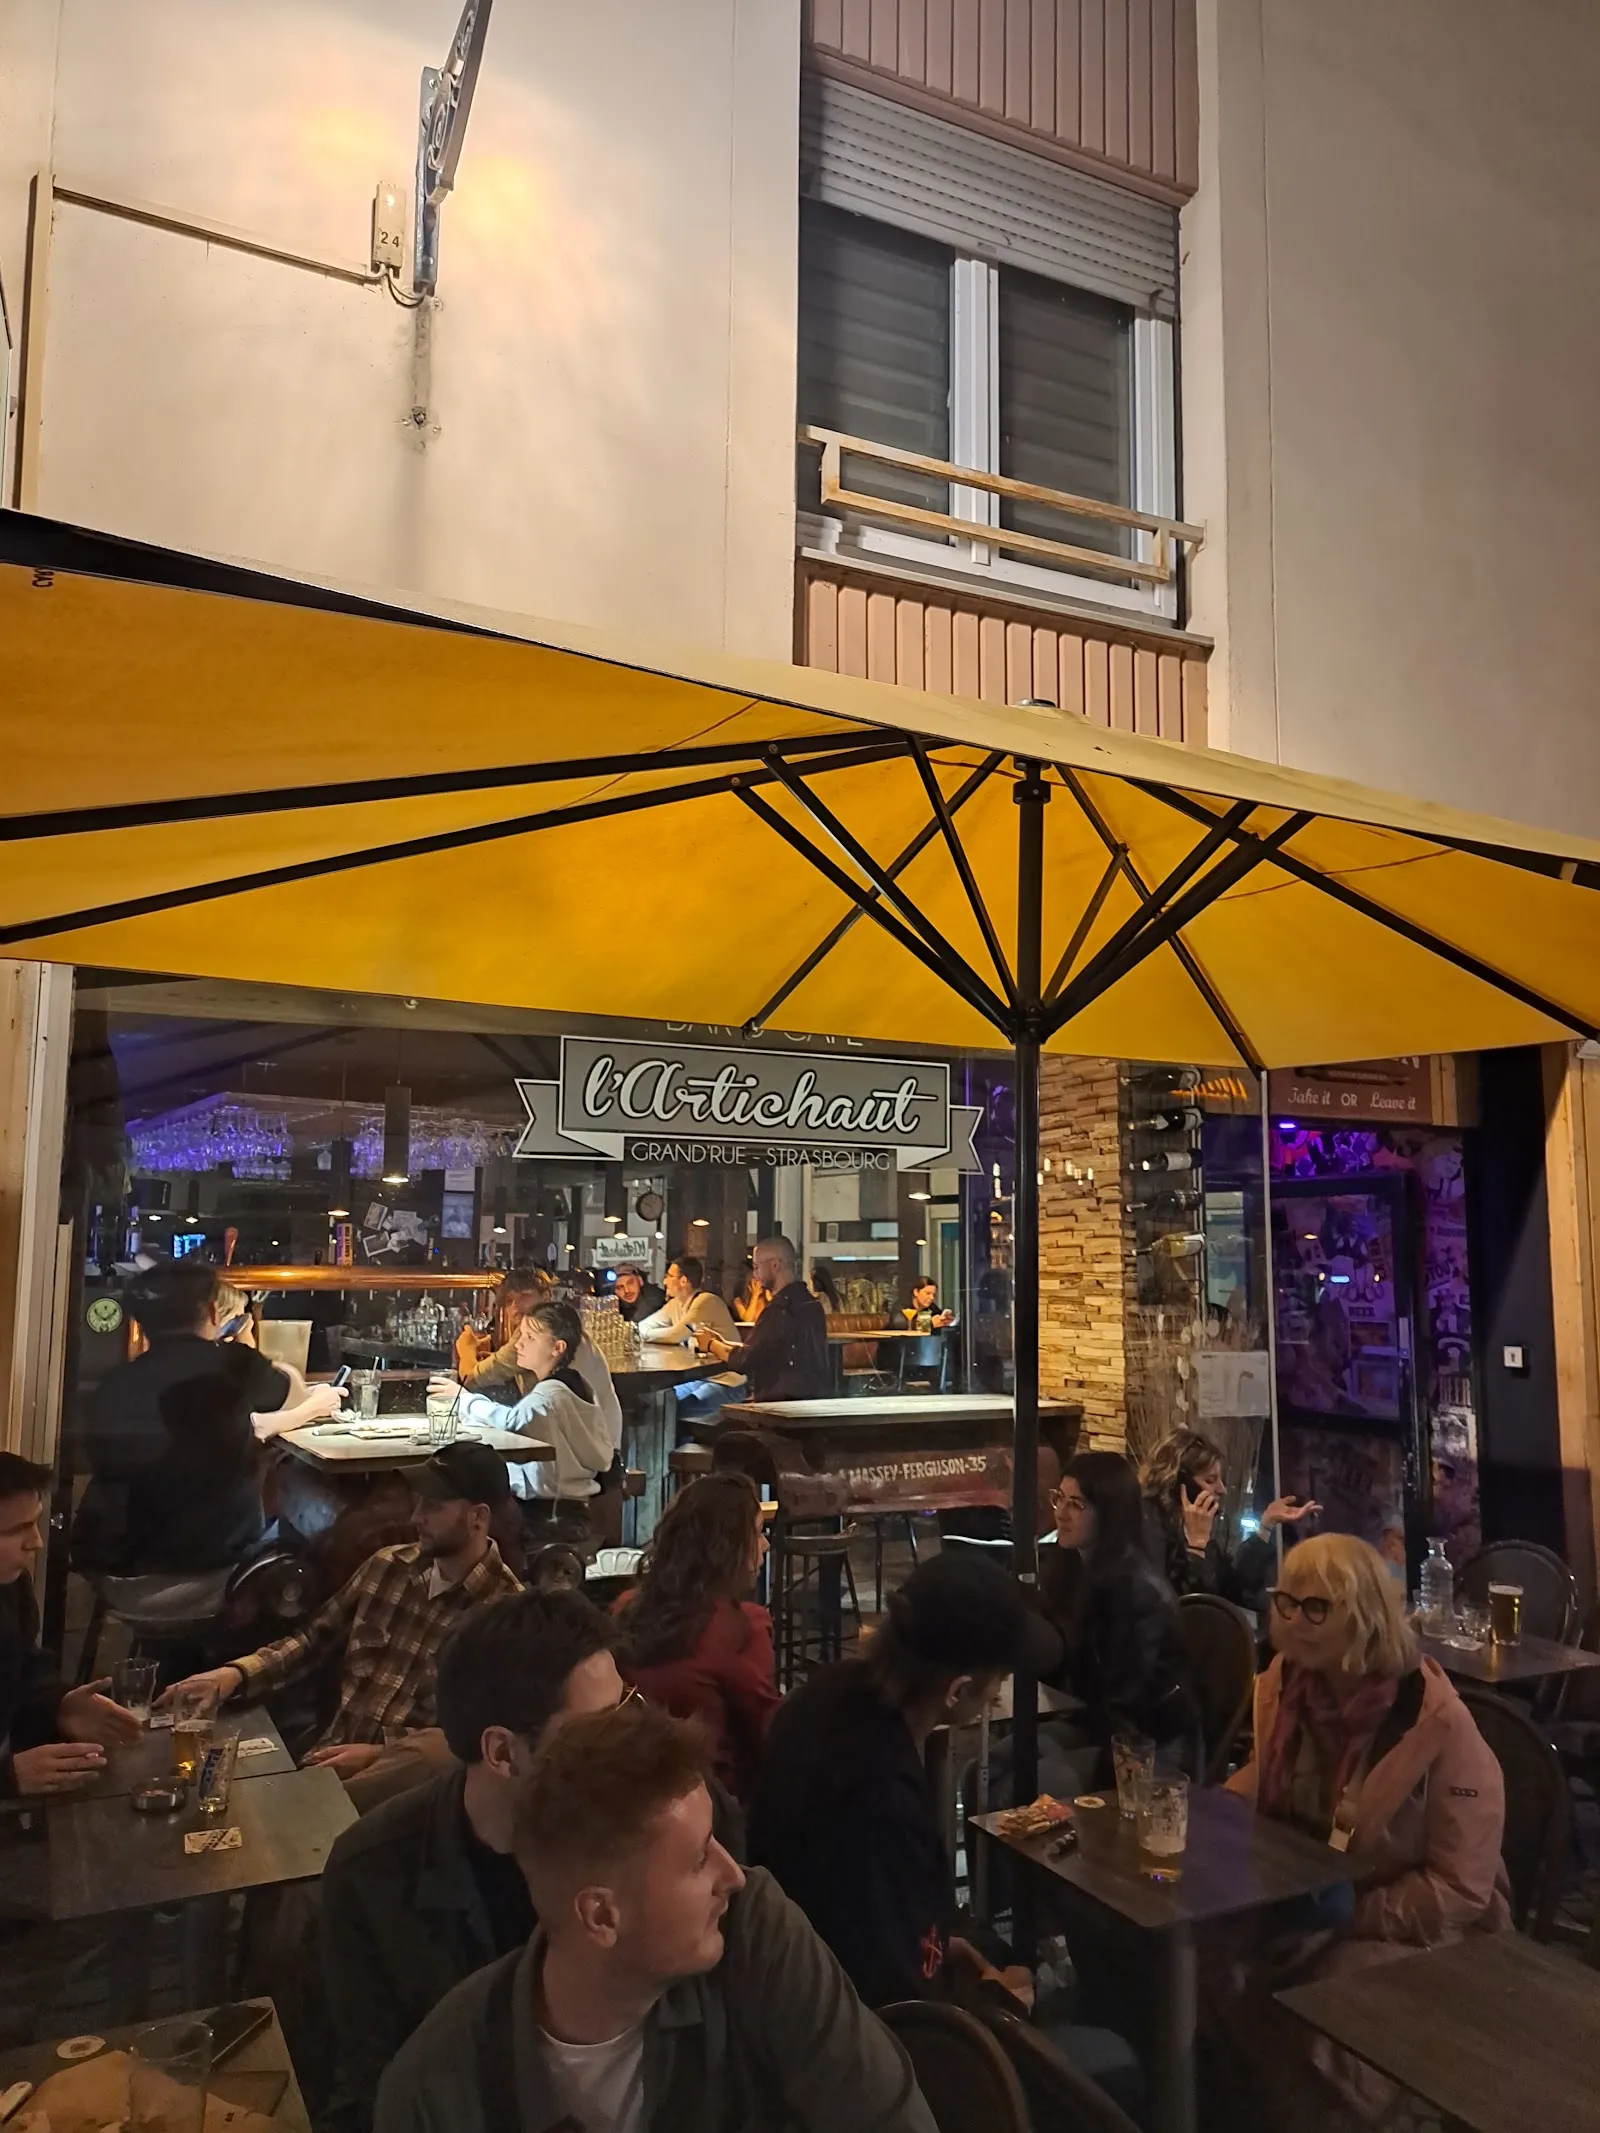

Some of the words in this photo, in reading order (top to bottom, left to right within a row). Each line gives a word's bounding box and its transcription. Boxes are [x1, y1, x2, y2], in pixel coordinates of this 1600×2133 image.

[585, 1056, 938, 1133] l'Artichaut
[1288, 1087, 1319, 1105] Take
[1322, 1090, 1331, 1105] it
[1341, 1093, 1358, 1106] OR
[1370, 1091, 1405, 1110] Leave
[1407, 1096, 1416, 1110] it
[631, 1142, 746, 1165] GRAND'RUE
[765, 1147, 890, 1171] STRASBOURG
